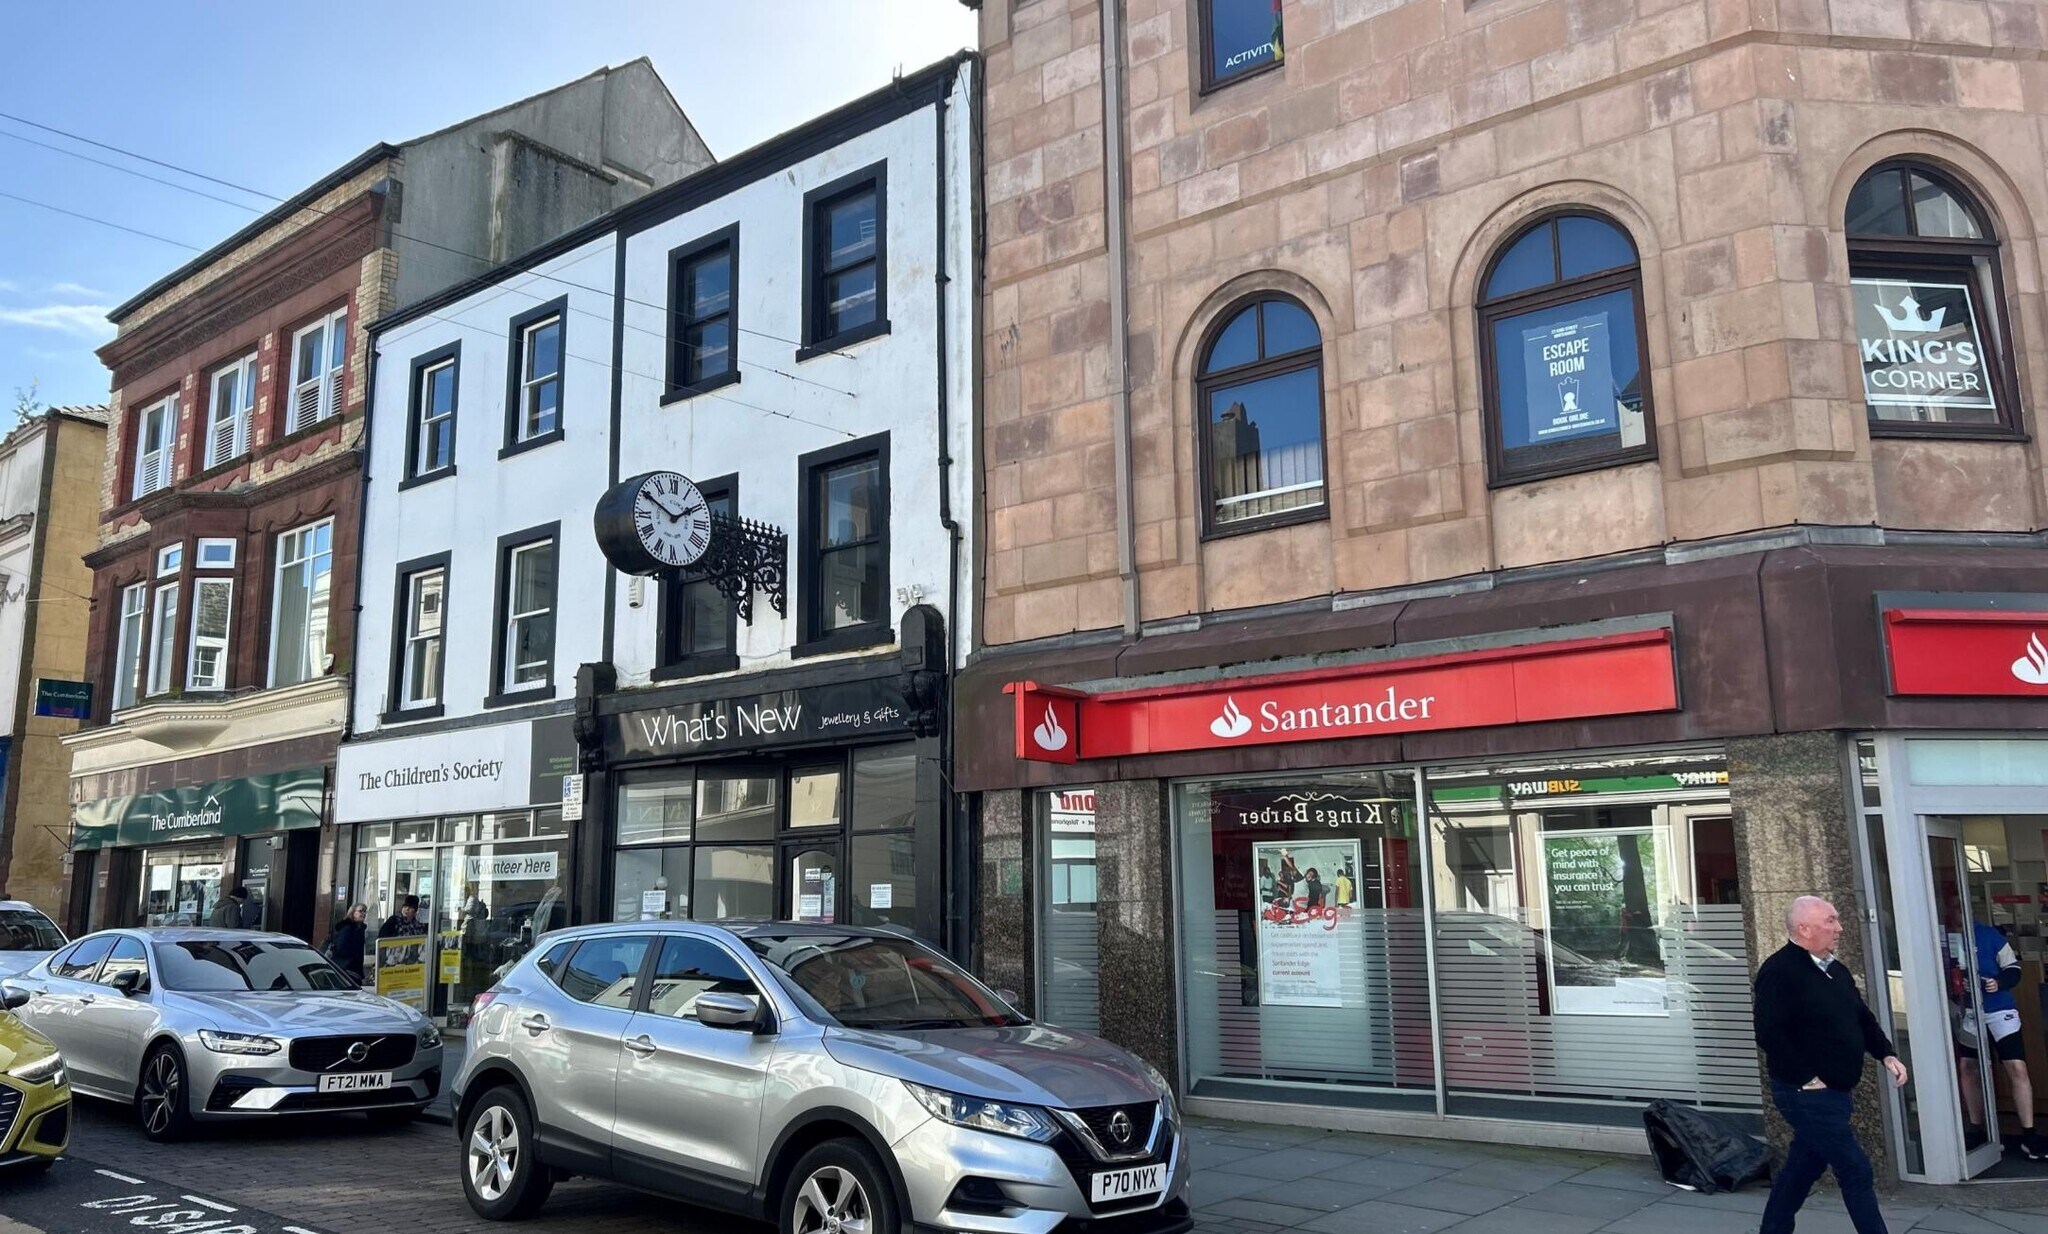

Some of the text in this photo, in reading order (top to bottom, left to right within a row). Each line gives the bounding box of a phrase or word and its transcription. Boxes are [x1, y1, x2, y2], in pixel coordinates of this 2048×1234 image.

[1225, 42, 1275, 69] ACTIVITY
[1543, 337, 1590, 361] ESCAPE
[1860, 338, 1978, 365] KING'S
[1549, 356, 1585, 377] ROOM
[1870, 369, 1980, 391] CORNER
[817, 712, 861, 730] Jewellery
[873, 706, 900, 721] Gifts
[1260, 686, 1435, 734] Santander
[640, 704, 803, 747] What's New
[359, 759, 504, 791] The Children's Society
[151, 805, 222, 832] The Cumberland
[1551, 846, 1610, 859] Get peace of
[1553, 859, 1599, 869] mind with
[524, 857, 551, 873] Here
[1553, 871, 1598, 880] insurance
[1554, 882, 1614, 894] you can trust
[327, 1074, 384, 1089] FT21 MWA
[1103, 1167, 1158, 1195] P70 NYX
